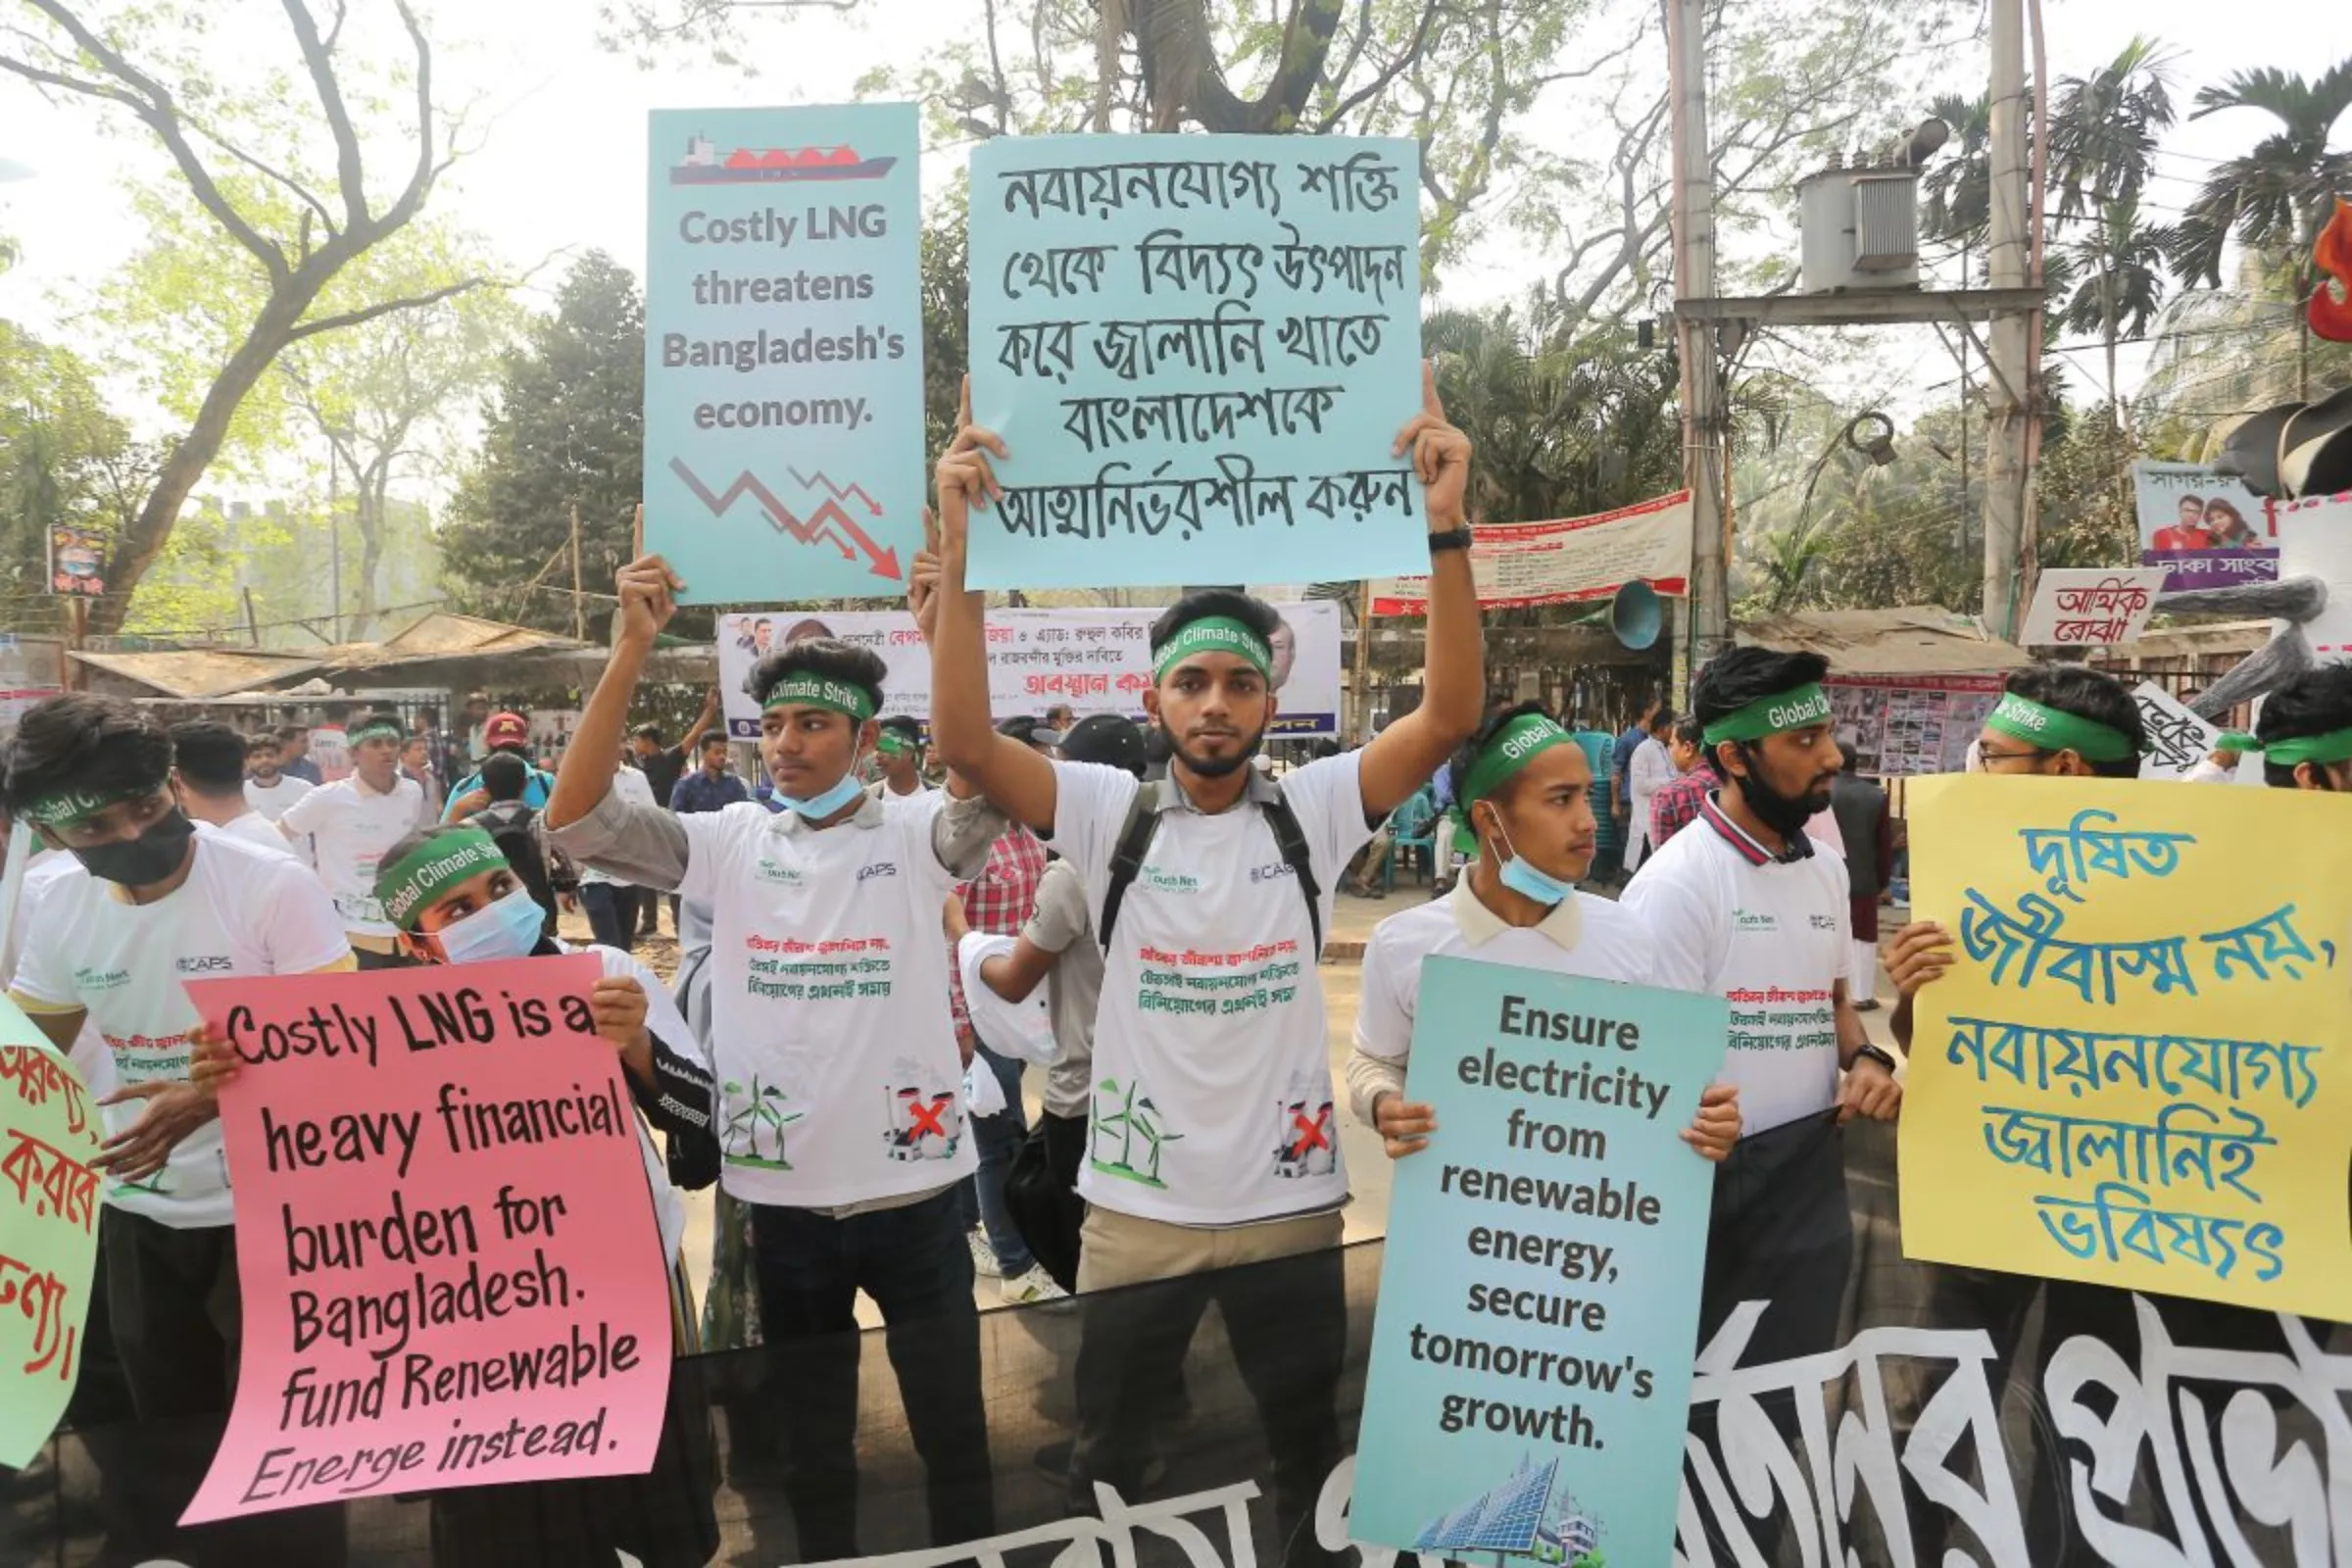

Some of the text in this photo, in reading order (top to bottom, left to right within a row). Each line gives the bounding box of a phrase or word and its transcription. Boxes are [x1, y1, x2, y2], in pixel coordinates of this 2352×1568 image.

[999, 151, 1399, 220] নবায়নযোগ্য শক্তি
[680, 205, 887, 248] Costly LNG
[693, 270, 874, 305] threatens
[1004, 245, 1118, 299] থেকে
[1272, 221, 1406, 305] উৎপাদন
[663, 325, 905, 373] Bangladesh's
[998, 300, 1389, 383] করে জ্বালানি খাতে
[694, 396, 873, 430] economy.
[1060, 385, 1345, 452] বাংলাদেশকে
[997, 454, 1298, 540] আত্মনির্ভরশীল
[1306, 469, 1413, 521] করুন
[1183, 627, 1239, 647] Climate
[1501, 720, 1554, 760] Global
[1768, 696, 1817, 728] Global
[416, 847, 479, 889] Climate
[2018, 808, 2198, 903] দূষিত
[227, 988, 597, 1066] Costly LNG is a
[1499, 995, 1640, 1051] Ensure
[1457, 1048, 1670, 1119] electricity
[1946, 1015, 2323, 1110] নবায়নযোগ্য
[261, 1106, 421, 1178] heavy
[436, 1078, 626, 1152] financial
[1506, 1108, 1606, 1160] from
[1982, 1102, 2277, 1204] জ্বালানিই
[1440, 1162, 1662, 1226] renewable
[282, 1185, 567, 1275] burden for
[1468, 1225, 1618, 1284] energy,
[2034, 1183, 2284, 1282] ভবিষ্যৎ
[290, 1248, 585, 1359] Bangladesh.
[1467, 1281, 1606, 1332] secure
[402, 1322, 640, 1409] Renewable
[1410, 1324, 1653, 1399] tomorrow's
[1439, 1392, 1604, 1449] growth.
[239, 1407, 617, 1505] Energe instead.
